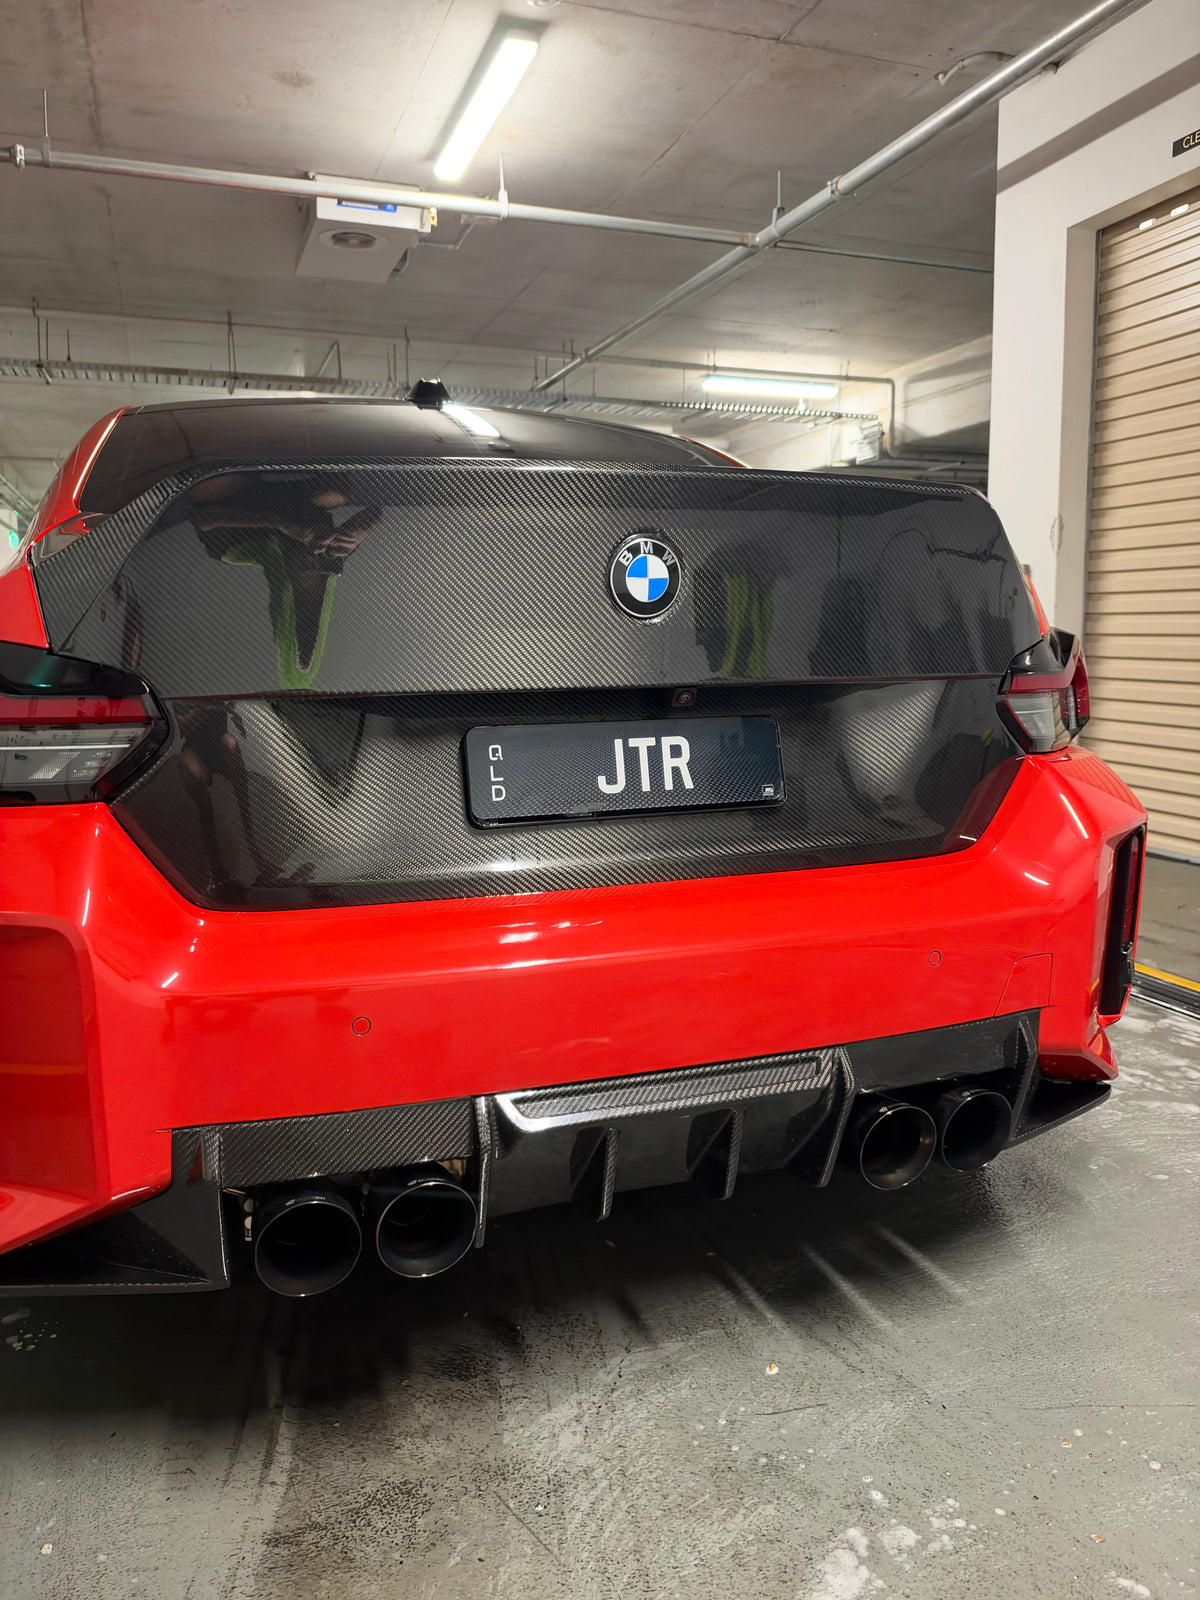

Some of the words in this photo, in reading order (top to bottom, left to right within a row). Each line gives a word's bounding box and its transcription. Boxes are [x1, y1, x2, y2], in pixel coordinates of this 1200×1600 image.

[618, 541, 676, 567] BMW
[488, 744, 506, 802] QLD
[597, 735, 694, 794] JTR
